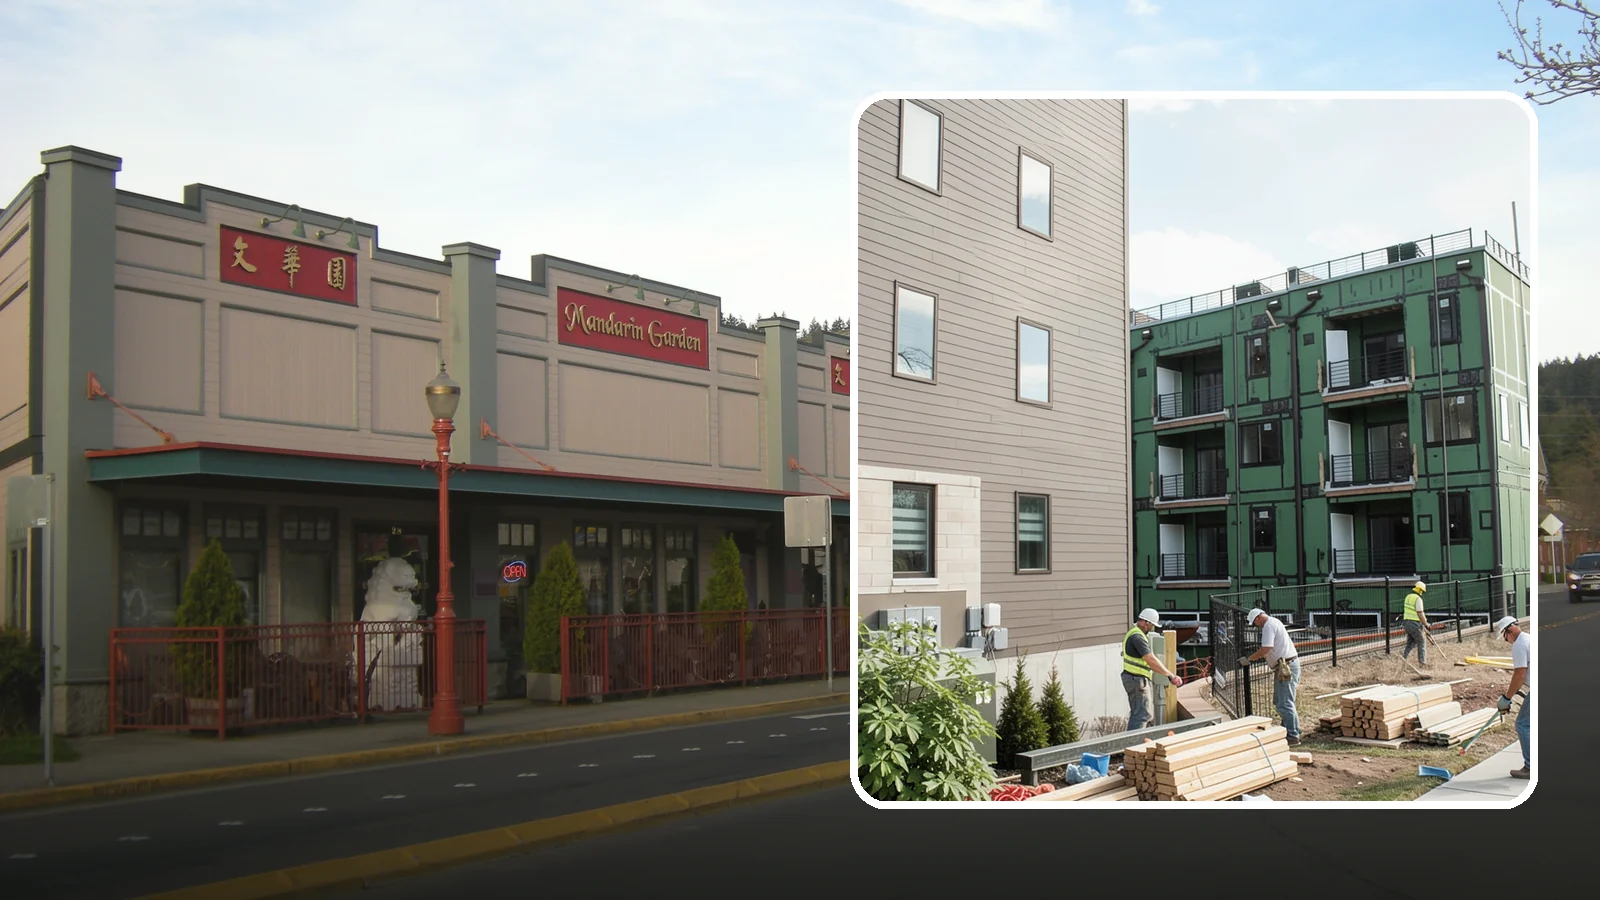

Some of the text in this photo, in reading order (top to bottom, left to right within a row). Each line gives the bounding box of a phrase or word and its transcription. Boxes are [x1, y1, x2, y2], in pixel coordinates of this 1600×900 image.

[564, 302, 701, 352] Mandarin Garden
[503, 565, 527, 578] OPEN
